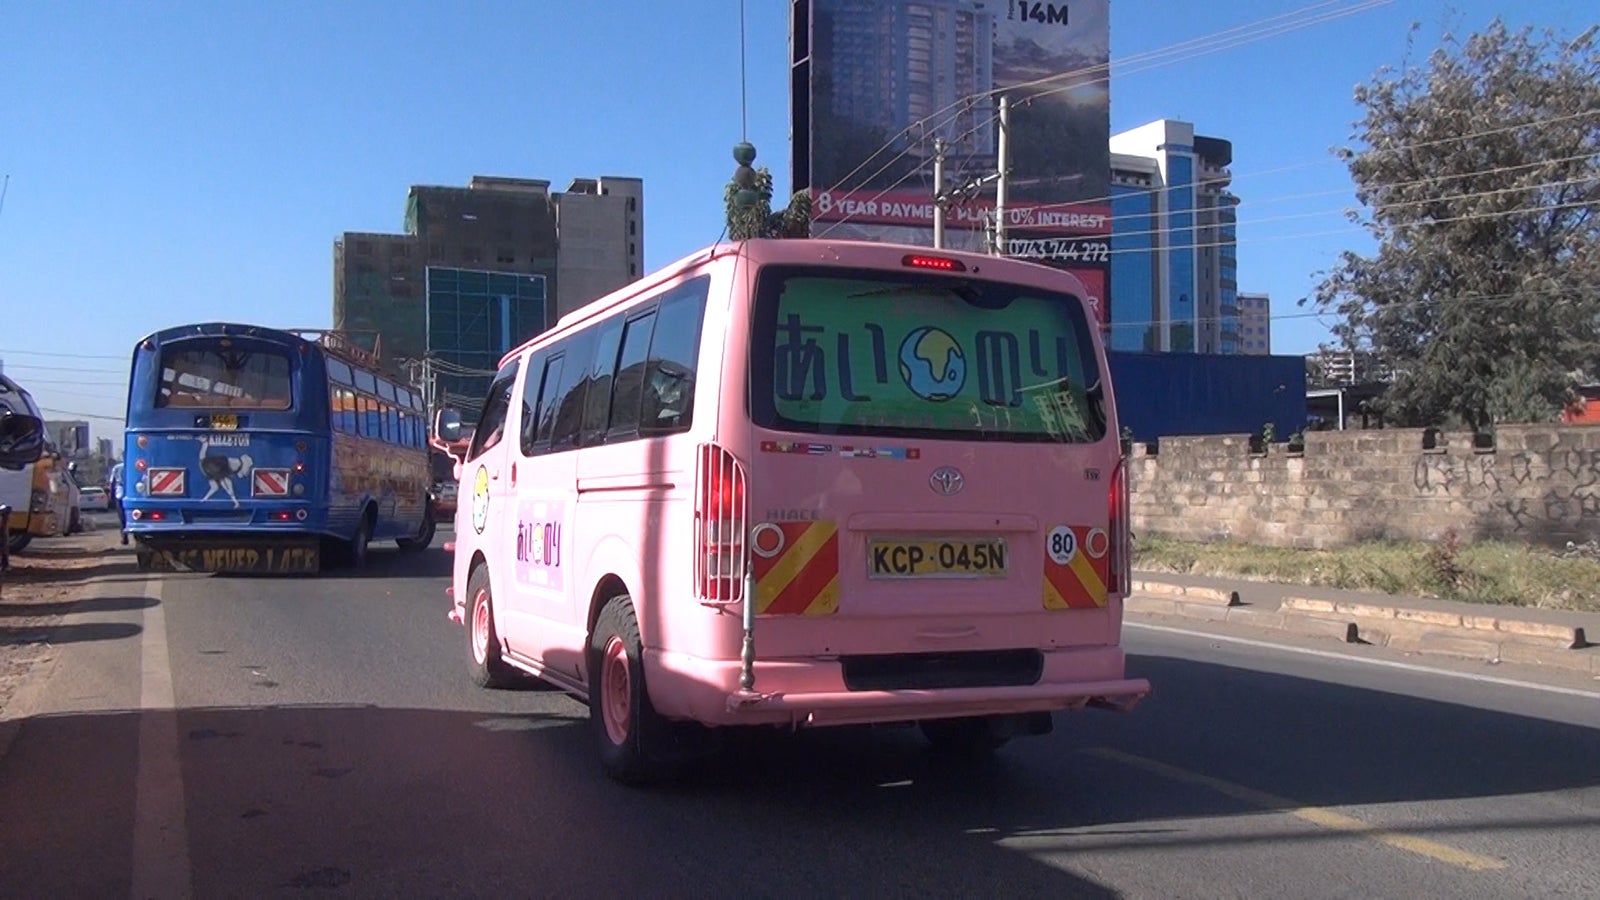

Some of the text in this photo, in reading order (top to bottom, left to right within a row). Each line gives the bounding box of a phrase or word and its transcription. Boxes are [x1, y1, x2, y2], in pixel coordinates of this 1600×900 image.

[1019, 1, 1068, 25] 14M
[820, 192, 831, 212] 8
[837, 200, 877, 215] YEAR
[881, 201, 953, 220] PAYME
[1011, 208, 1034, 225] 0%
[1038, 212, 1106, 228] INTEREST
[1050, 242, 1079, 261] 744
[1082, 243, 1109, 262] 272
[767, 509, 820, 521] HIACE
[1052, 533, 1073, 554] 80
